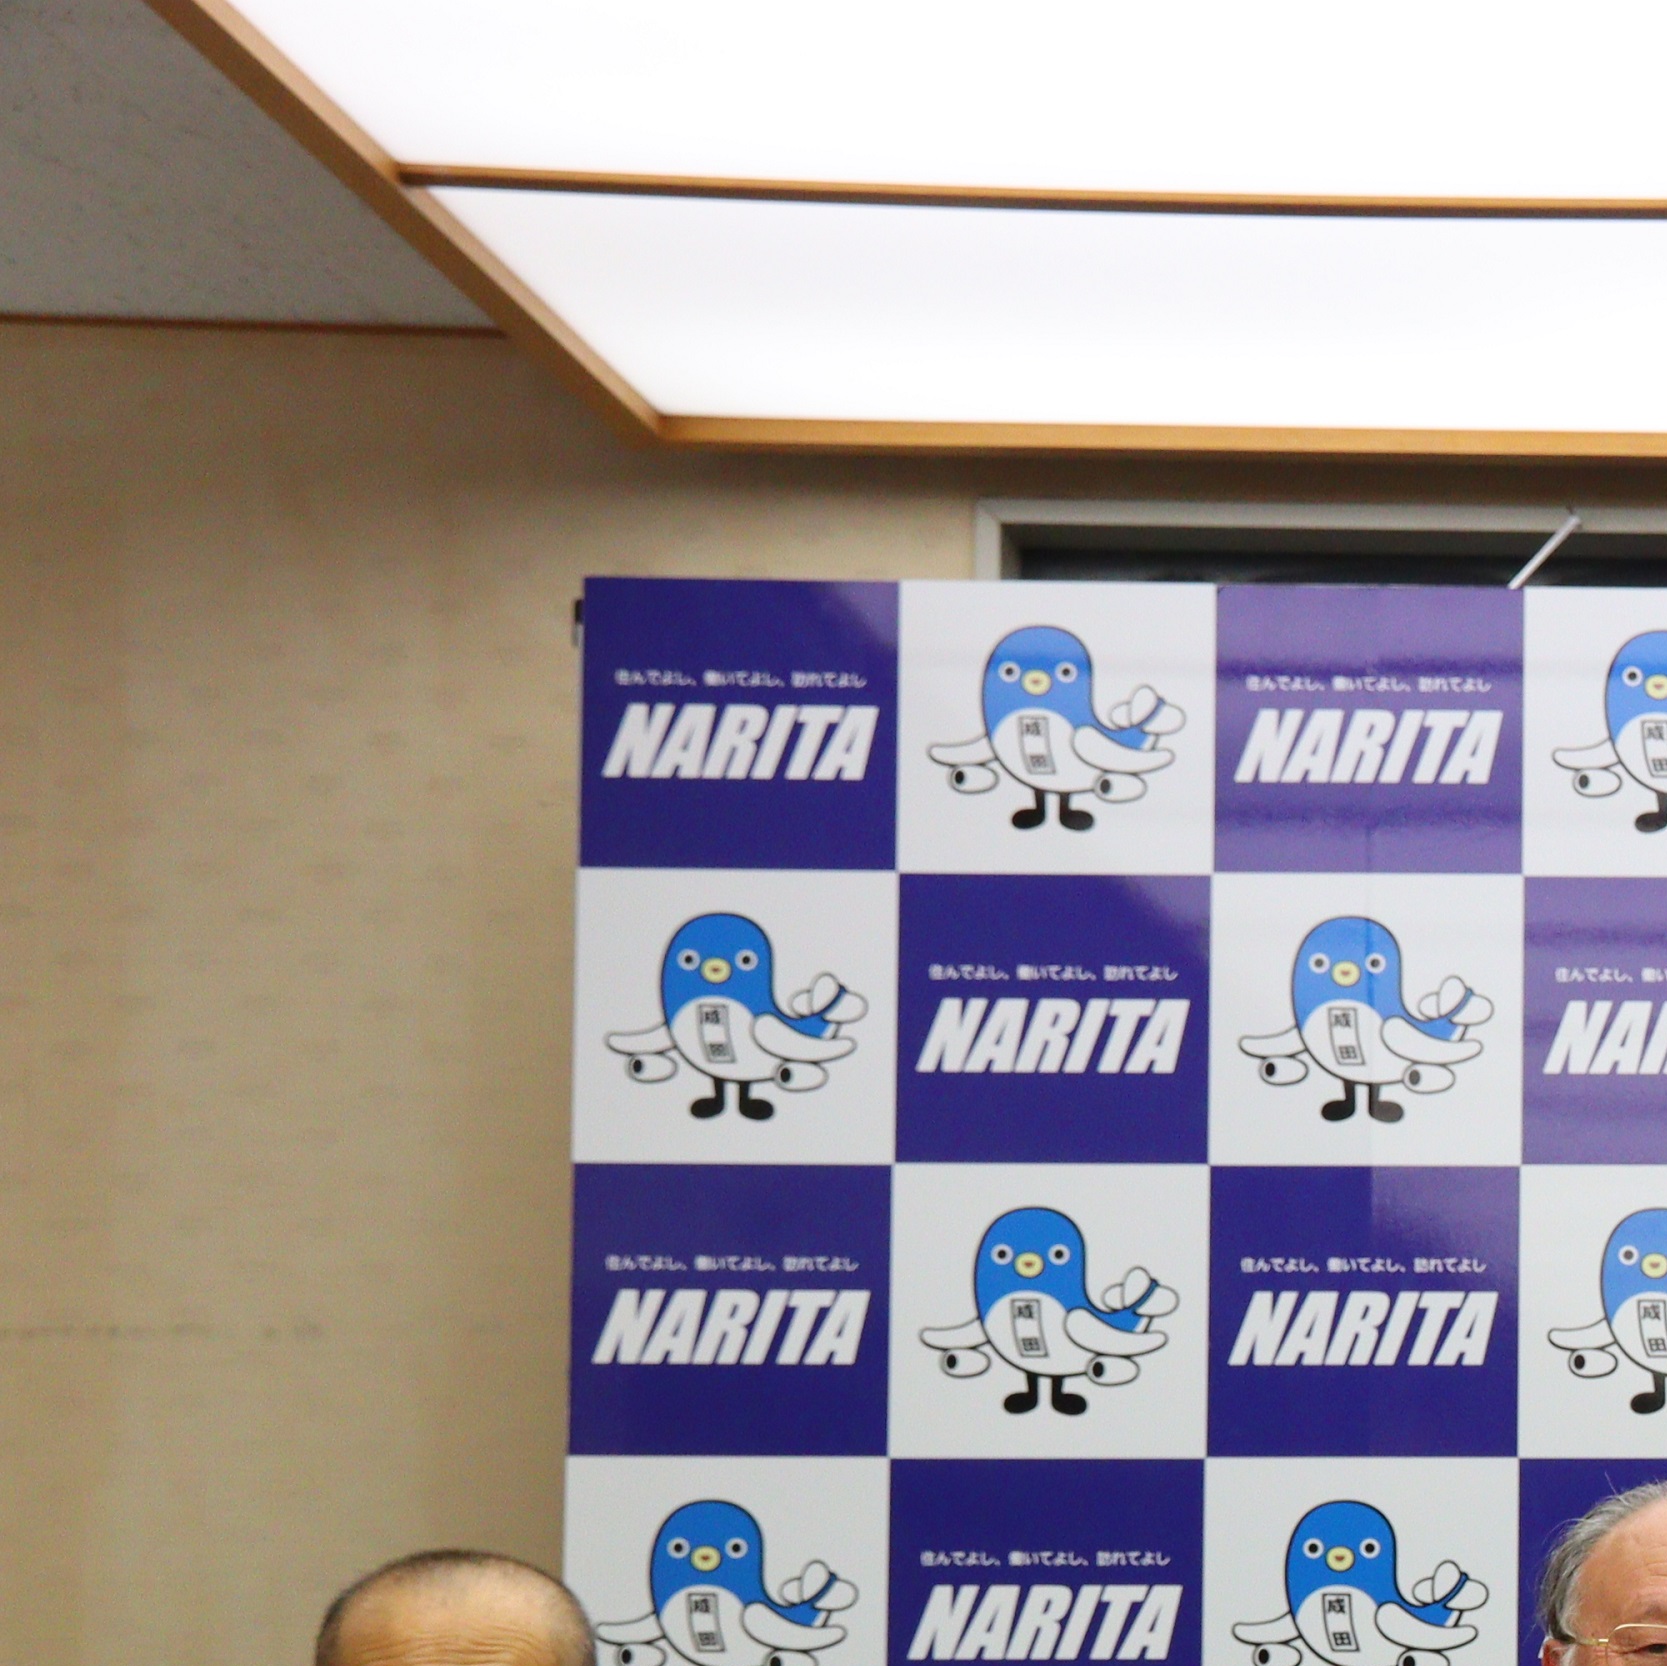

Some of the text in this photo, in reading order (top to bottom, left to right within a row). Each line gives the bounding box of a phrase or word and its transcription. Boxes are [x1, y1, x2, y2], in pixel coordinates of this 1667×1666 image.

[603, 704, 879, 780] NARITA
[1235, 709, 1503, 784] NARITA
[916, 998, 1190, 1073] NARITA
[1333, 1012, 1356, 1060] 成田
[1239, 1256, 1487, 1274] 住んでよし、働いてよし、訪れてよし
[592, 1289, 870, 1365] NARITA
[1015, 1303, 1040, 1352] 成田
[1229, 1291, 1498, 1365] NARITA
[1642, 1304, 1666, 1352] 成田
[908, 1585, 1182, 1660] NARITA
[1327, 1598, 1353, 1647] 成田
